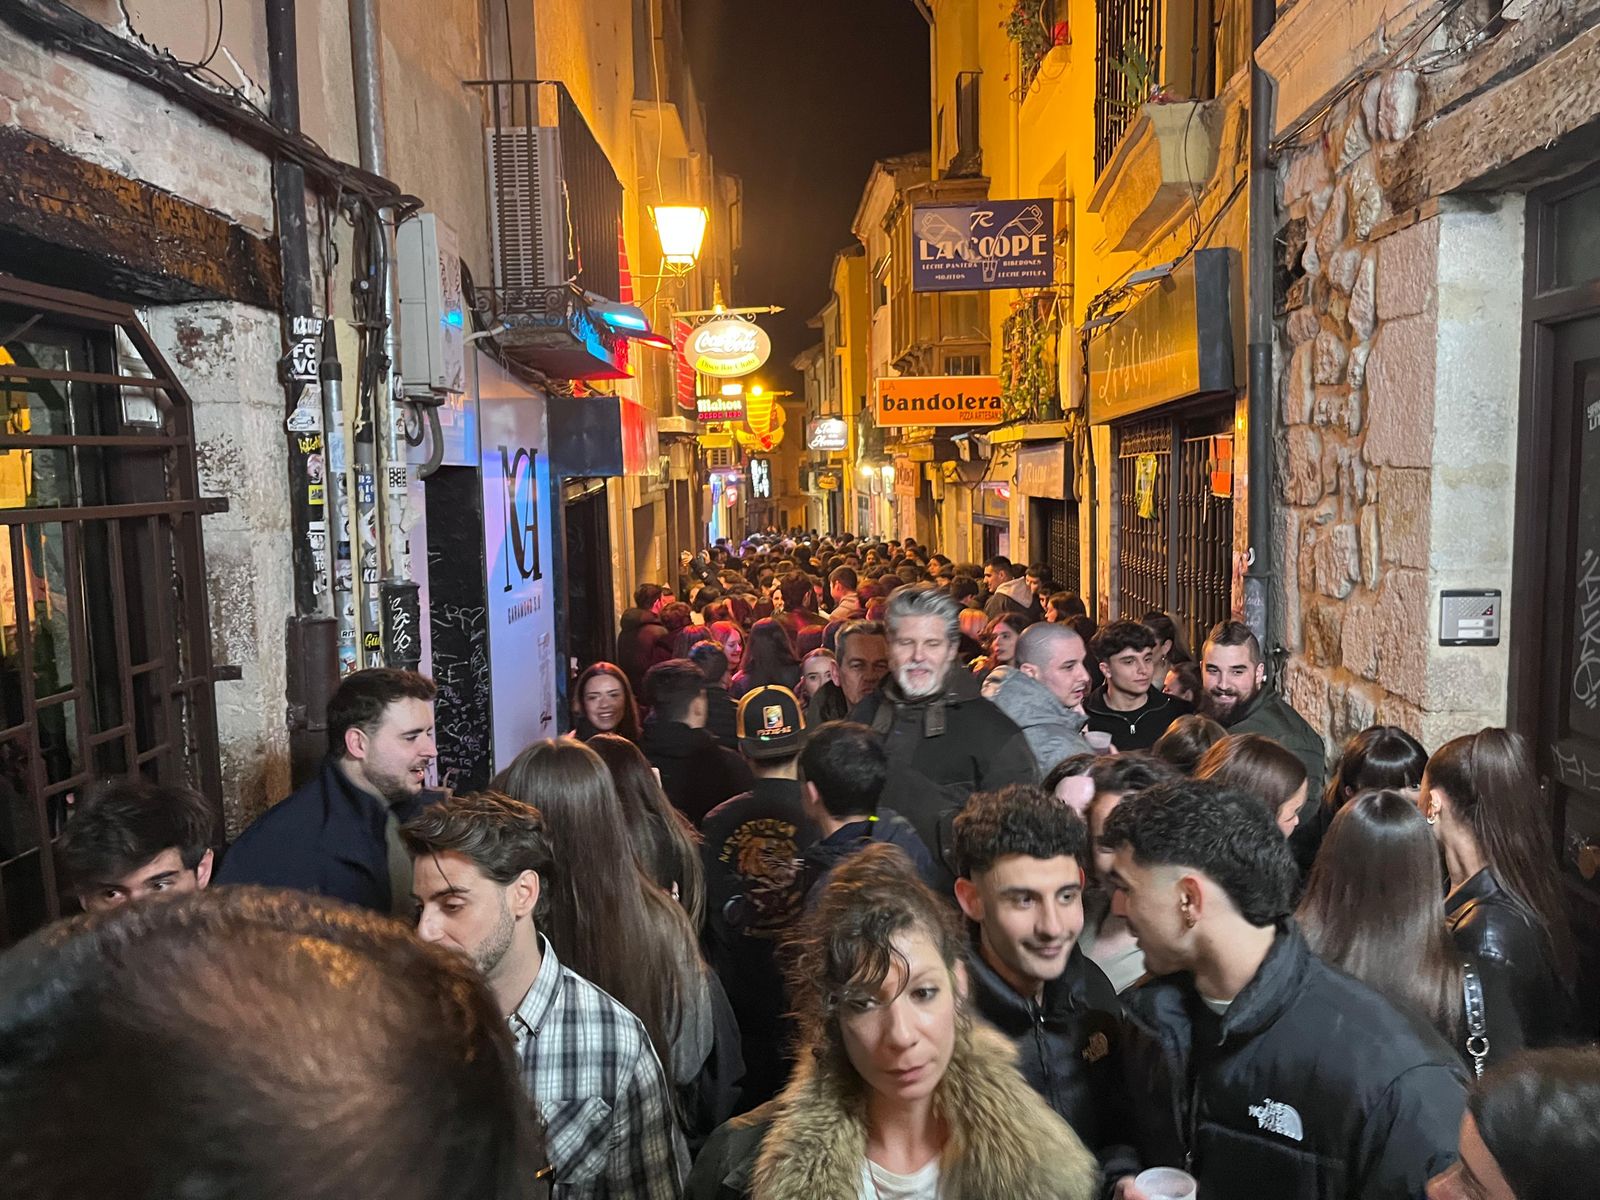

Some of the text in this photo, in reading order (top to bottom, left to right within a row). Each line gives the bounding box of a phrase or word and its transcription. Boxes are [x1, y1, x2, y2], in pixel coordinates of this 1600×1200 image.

[945, 262, 978, 270] PANTERA
[696, 398, 742, 413] Mahou
[882, 393, 1002, 412] bandolera
[698, 411, 723, 419] DESDE
[960, 411, 974, 420] PIZZA
